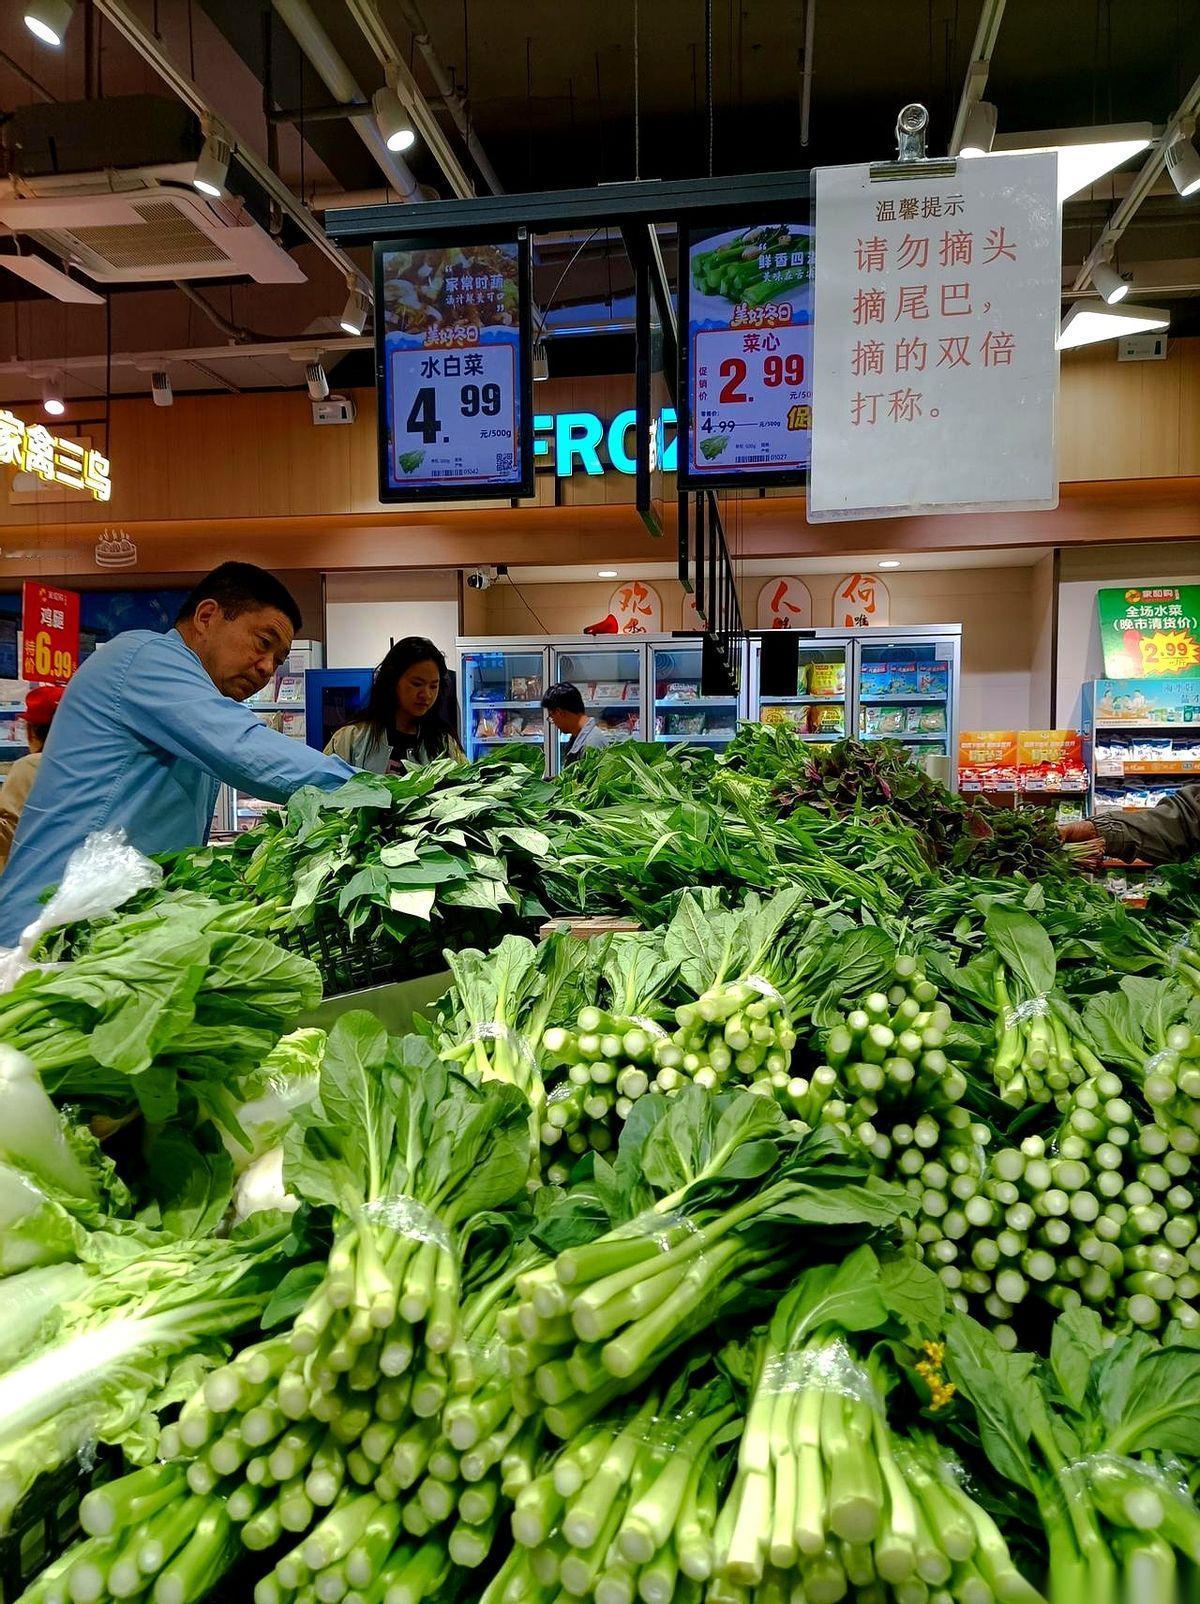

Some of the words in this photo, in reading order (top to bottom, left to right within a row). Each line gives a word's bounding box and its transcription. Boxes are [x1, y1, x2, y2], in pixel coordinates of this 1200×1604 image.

[876, 195, 965, 222] 温馨提示
[854, 227, 1018, 273] 请勿摘头
[852, 283, 991, 325] 摘尾巴，
[743, 333, 780, 352] 菜心
[851, 331, 1016, 376] 摘的双倍
[420, 354, 484, 378] 水白菜
[851, 388, 940, 426] 打称。
[480, 429, 512, 439] 元/500g
[702, 418, 735, 434] 4.99
[619, 580, 652, 616] 欢
[771, 580, 801, 612] 人
[842, 573, 876, 613] 何
[40, 607, 65, 630] 鸡腿
[1126, 605, 1182, 618] 全场水菜
[35, 631, 72, 679] 6.99
[1144, 643, 1188, 663] 2.99
